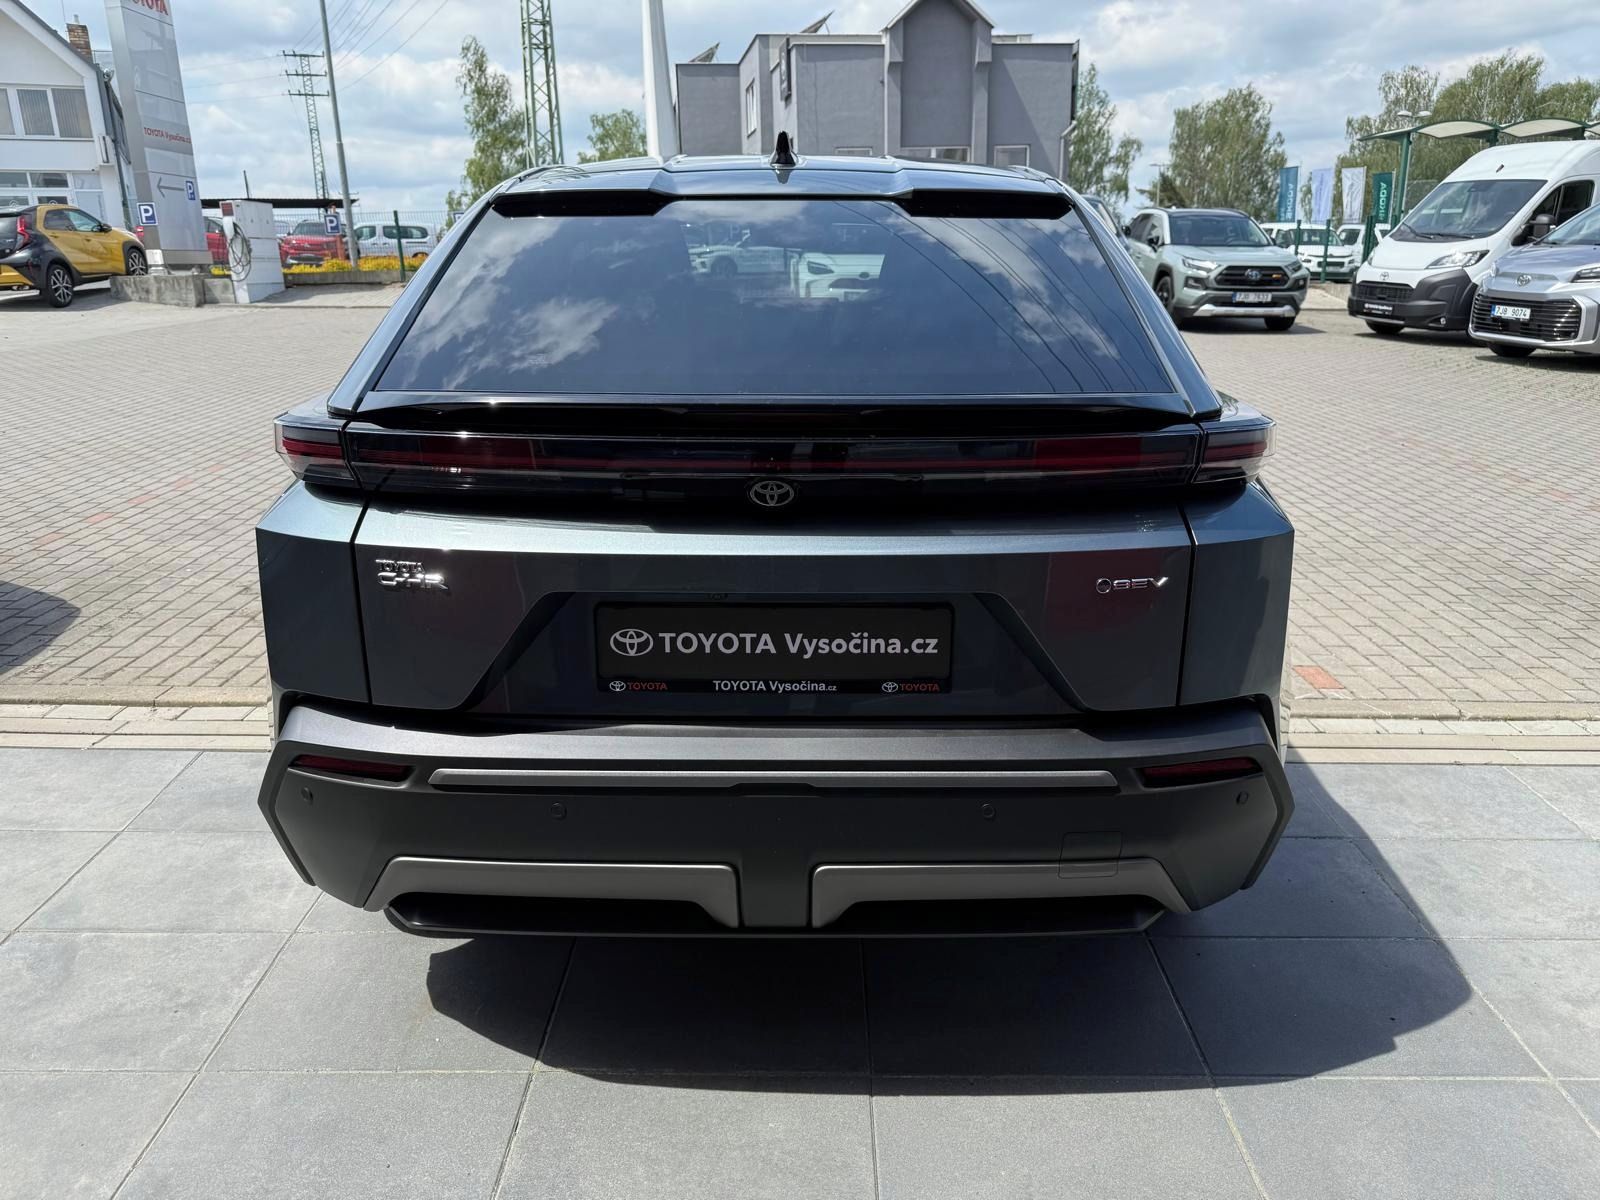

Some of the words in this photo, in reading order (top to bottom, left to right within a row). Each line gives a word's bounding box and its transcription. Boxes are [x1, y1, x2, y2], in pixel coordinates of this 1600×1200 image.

[144, 127, 164, 138] TOYOTA
[140, 206, 153, 223] P
[326, 216, 337, 232] P
[374, 559, 425, 573] TOYOTA
[659, 632, 776, 654] TOYOTA
[784, 632, 939, 659] Vysočina.cz
[627, 682, 668, 691] TOYOTA
[713, 680, 766, 691] TOYOTA
[769, 680, 837, 693] Vysočina.cz
[900, 683, 940, 691] TOYOTA
